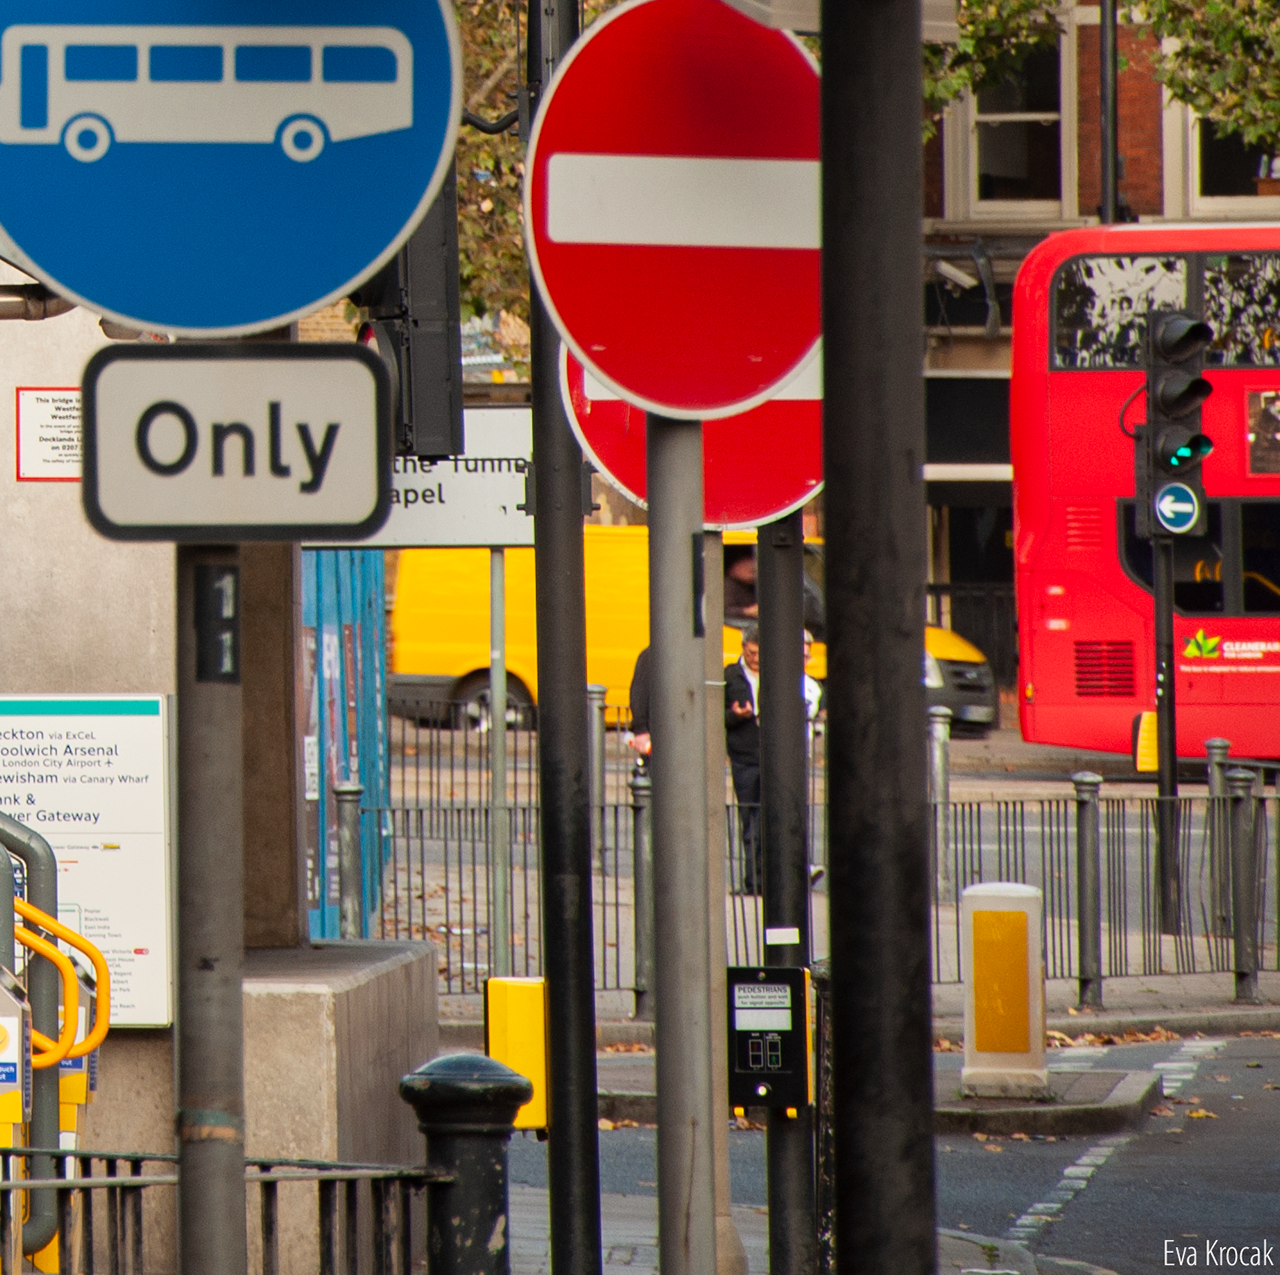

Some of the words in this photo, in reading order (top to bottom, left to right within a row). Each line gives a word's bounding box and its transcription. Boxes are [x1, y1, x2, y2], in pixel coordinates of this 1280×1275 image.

[135, 399, 341, 494] Only
[391, 483, 446, 509] apel
[49, 732, 62, 740] via
[66, 732, 96, 740] ExCeL
[63, 744, 119, 756] Arsenal
[2, 759, 39, 767] London
[43, 759, 63, 769] City
[66, 759, 101, 769] Airport
[63, 775, 77, 783] via
[80, 775, 114, 785] Canary
[118, 775, 149, 783] Wharf
[26, 794, 36, 805] &
[8, 812, 31, 821] wer
[36, 810, 100, 824] Gateway
